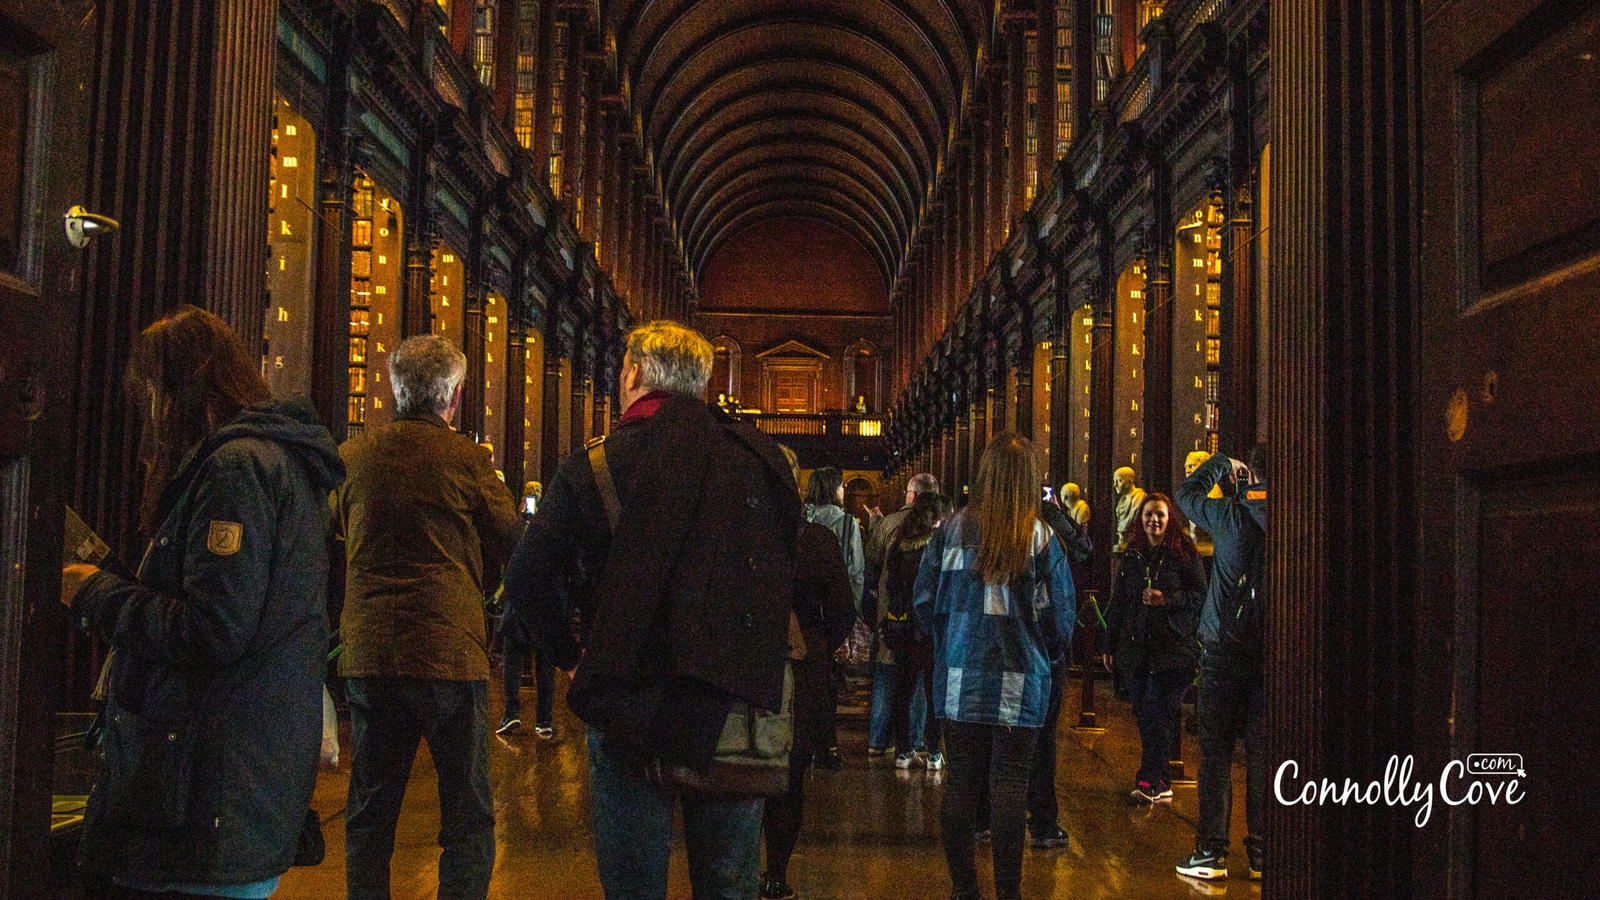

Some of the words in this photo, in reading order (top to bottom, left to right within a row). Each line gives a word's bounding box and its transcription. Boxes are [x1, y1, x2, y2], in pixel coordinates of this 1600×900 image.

[1195, 210, 1203, 219] o
[281, 221, 292, 235] k
[1193, 233, 1202, 243] n
[1193, 258, 1204, 267] m
[278, 307, 288, 321] h
[1195, 309, 1203, 321] k
[1194, 376, 1203, 388] h
